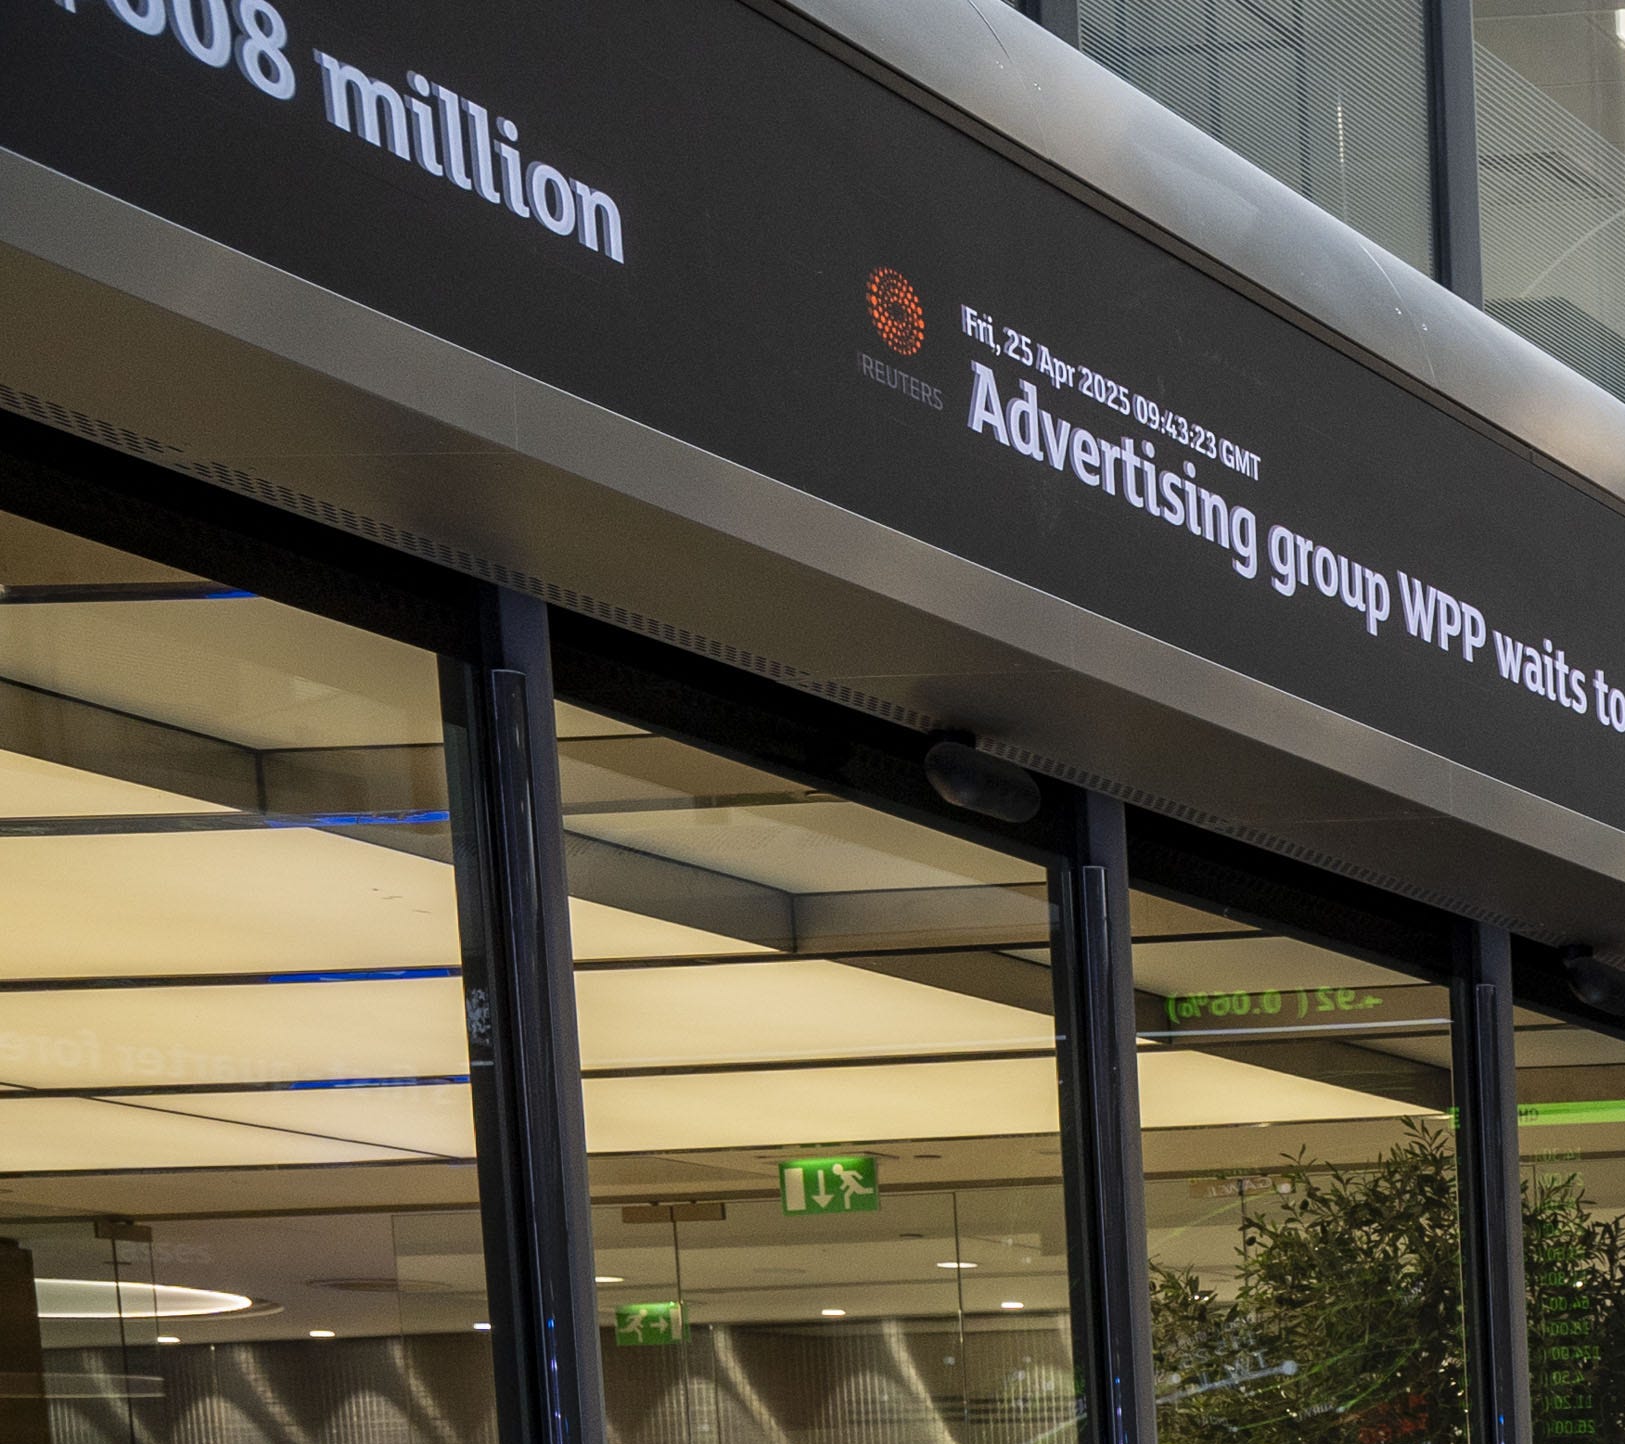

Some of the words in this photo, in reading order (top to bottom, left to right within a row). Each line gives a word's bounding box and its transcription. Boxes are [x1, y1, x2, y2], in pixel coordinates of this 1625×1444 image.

[313, 48, 624, 264] million
[862, 354, 943, 410] REUTERS
[961, 304, 1001, 356] Fri,
[1004, 327, 1033, 366] 25
[1037, 344, 1075, 389] Apr
[1078, 366, 1130, 415] 2025
[1132, 394, 1217, 459] 09:43:23
[1219, 438, 1261, 480] GMT
[967, 360, 1257, 579] Advertising
[1268, 525, 1390, 636] group
[1397, 570, 1486, 662] WPP
[1493, 630, 1587, 714] waits
